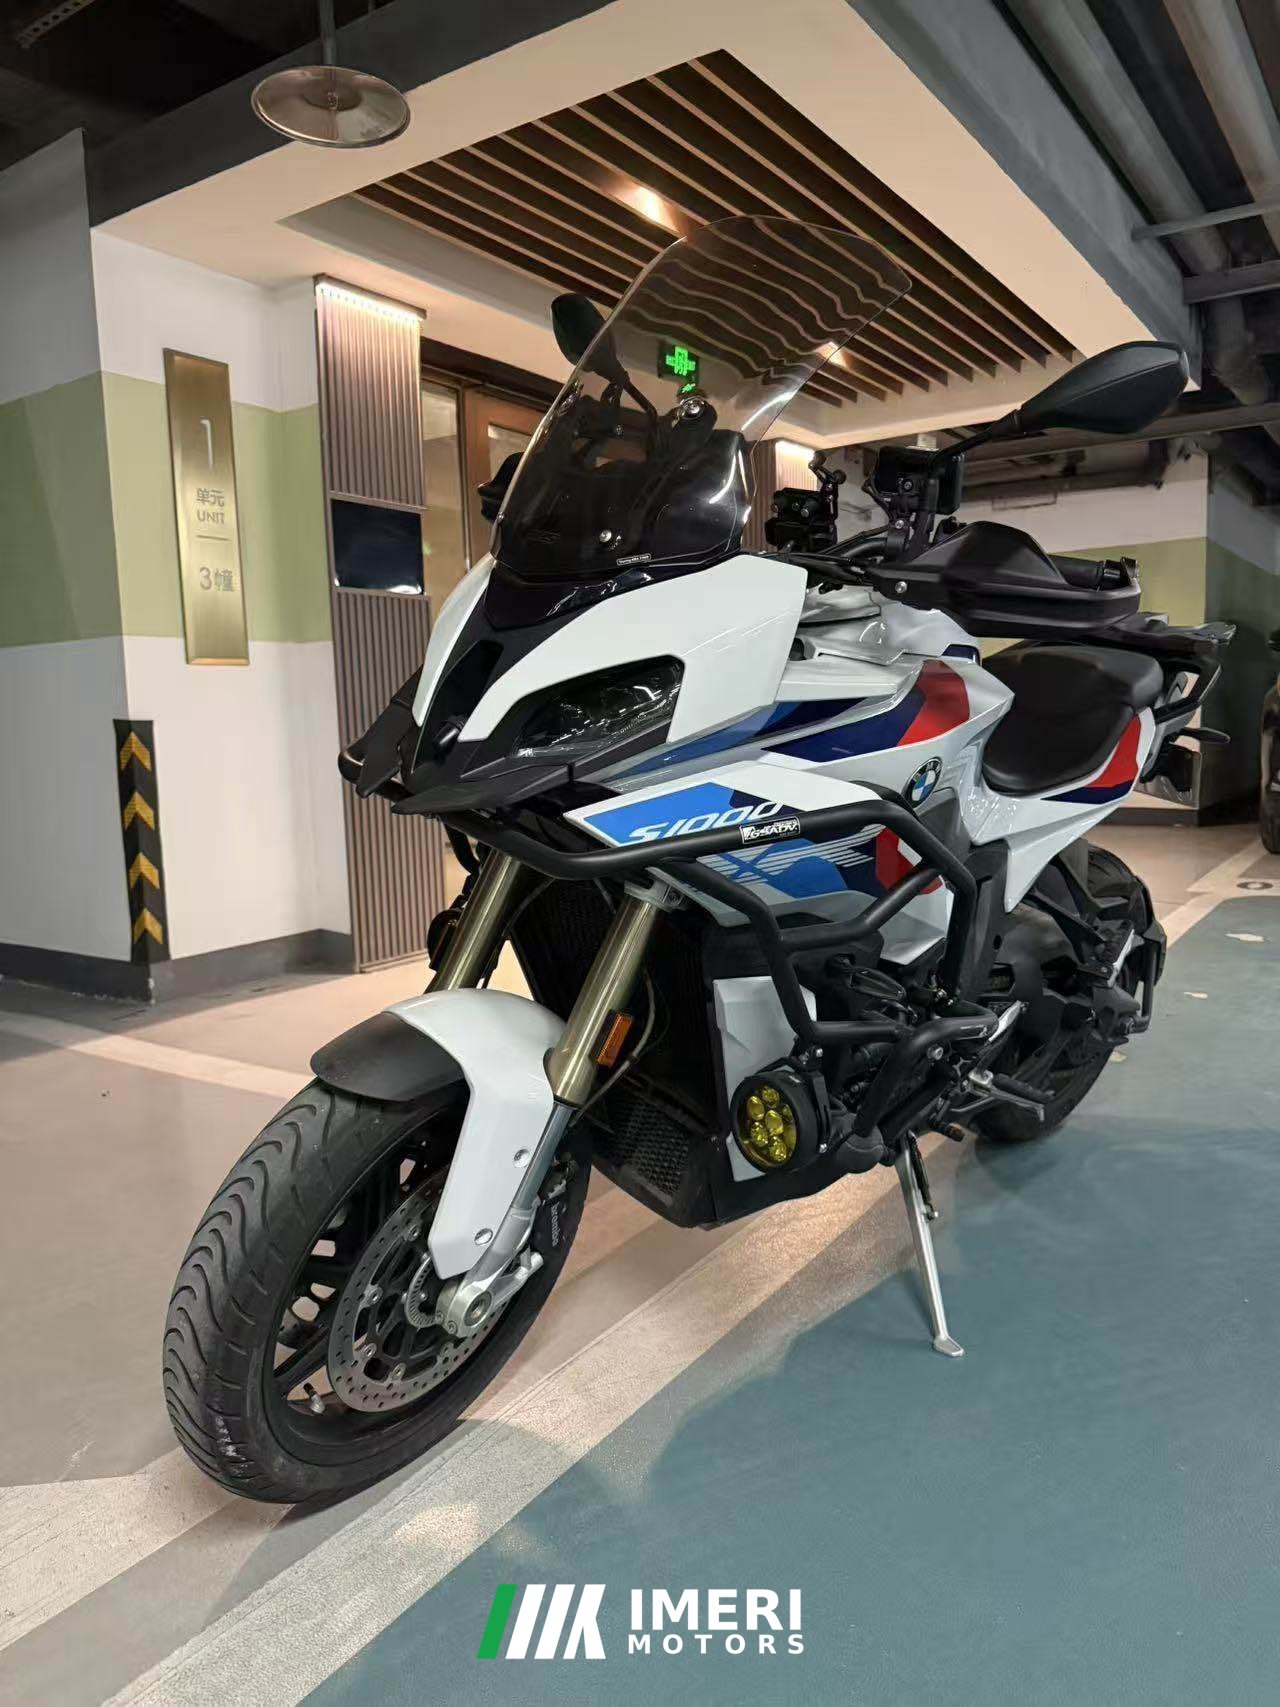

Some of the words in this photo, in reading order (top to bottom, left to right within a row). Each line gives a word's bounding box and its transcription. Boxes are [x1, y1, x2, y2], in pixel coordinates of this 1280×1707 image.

[200, 418, 214, 470] 1
[196, 488, 225, 507] 单元
[196, 510, 225, 524] UNIT
[629, 801, 783, 842] S1000
